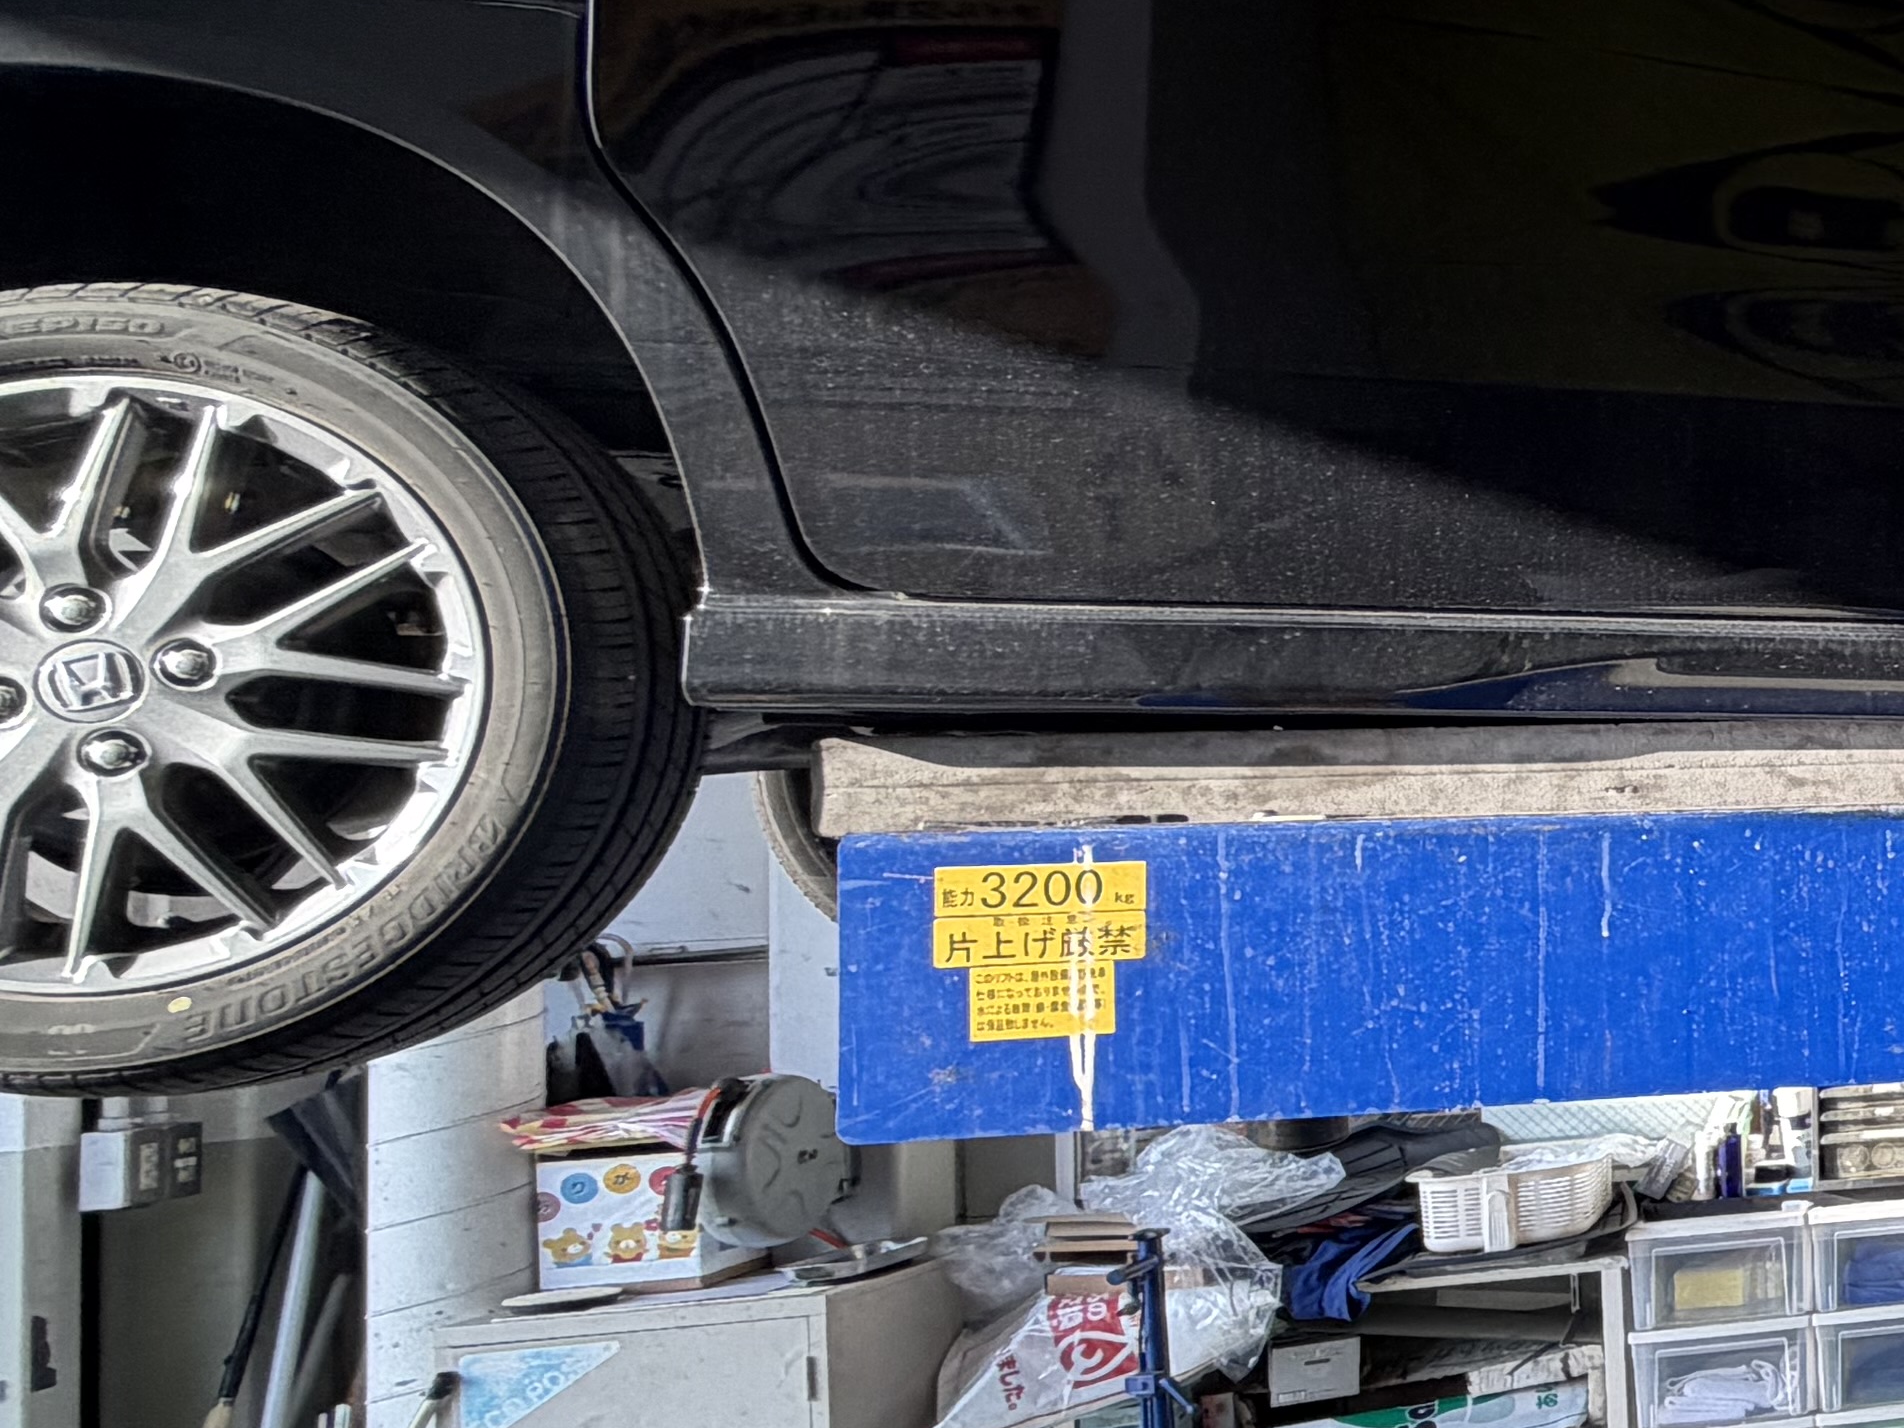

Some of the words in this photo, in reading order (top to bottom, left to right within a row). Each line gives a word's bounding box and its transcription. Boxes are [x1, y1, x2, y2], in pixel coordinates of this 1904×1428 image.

[942, 888, 975, 908] 能力
[980, 869, 1103, 909] 3200
[1114, 892, 1135, 904] kg
[945, 925, 1133, 963] 片上げ厳禁
